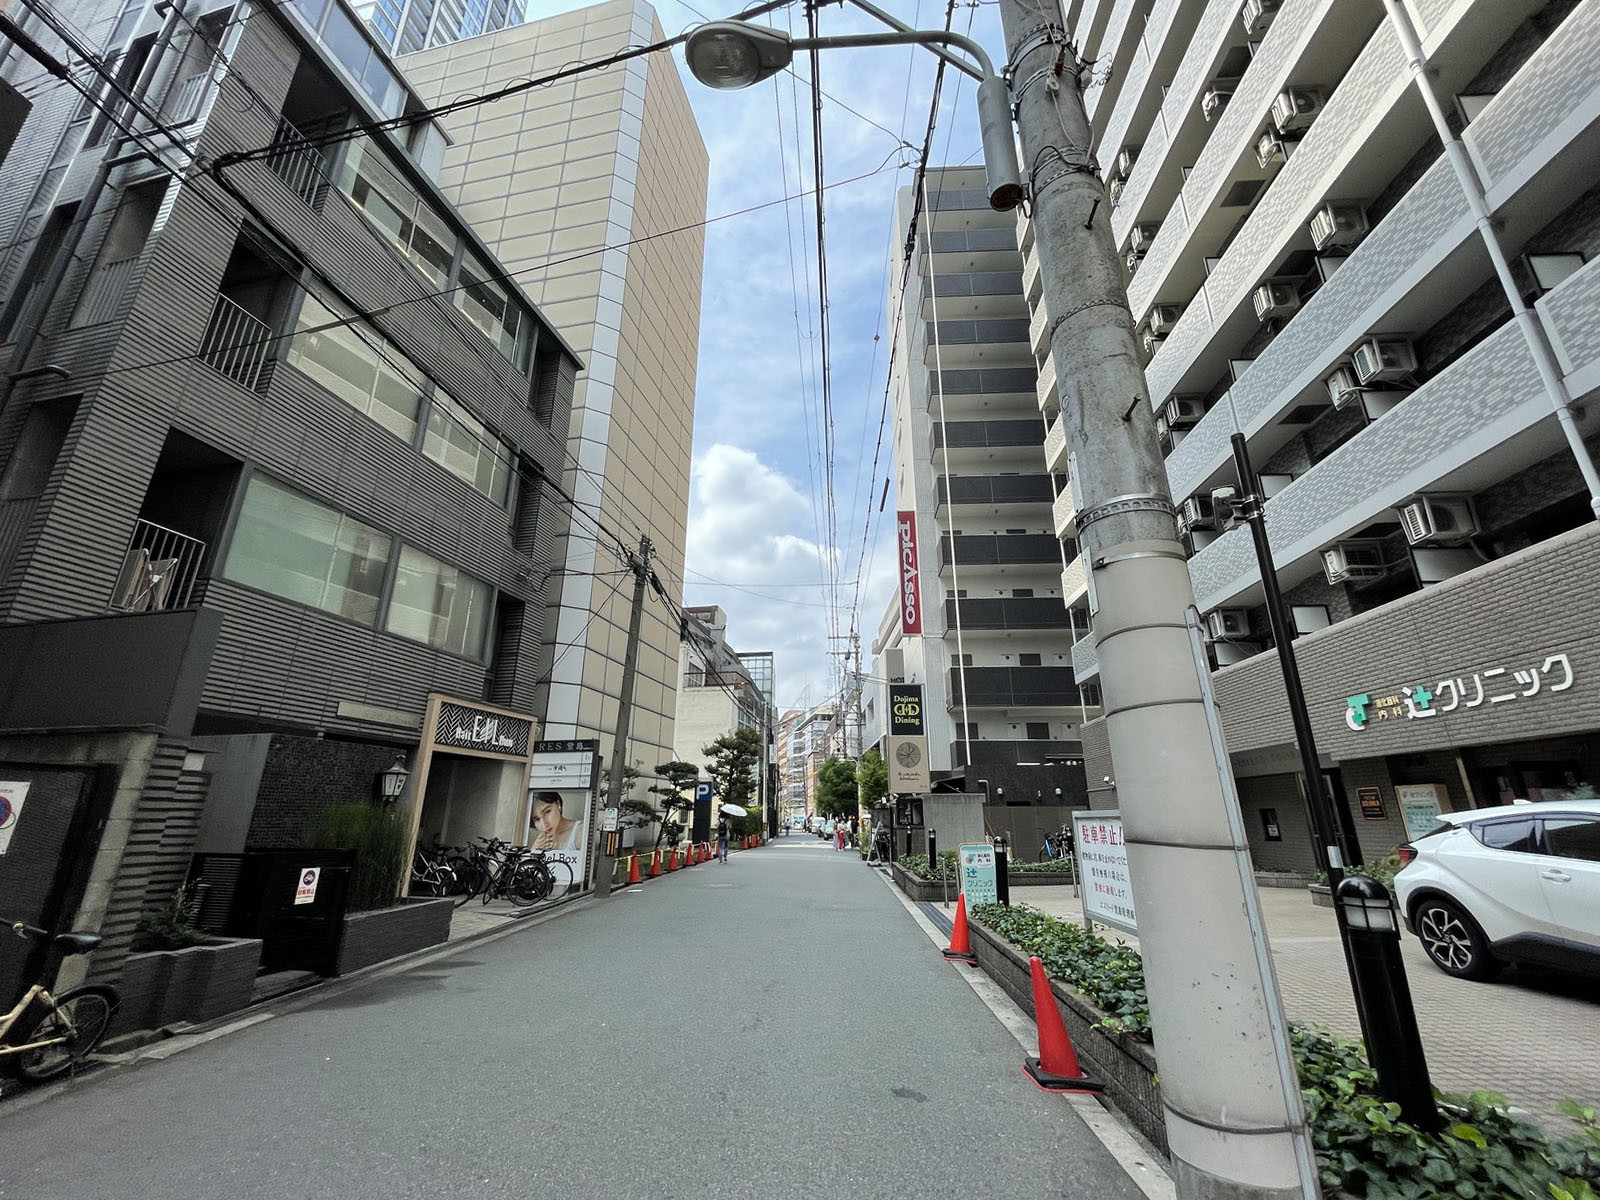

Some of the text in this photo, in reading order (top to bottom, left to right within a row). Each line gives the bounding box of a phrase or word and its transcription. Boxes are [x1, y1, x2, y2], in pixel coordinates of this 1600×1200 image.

[1402, 653, 1574, 720] 辻クリニック
[894, 695, 919, 703] Dojima
[895, 716, 920, 725] Dining
[455, 727, 472, 740] Hair
[696, 784, 709, 800] P
[1081, 824, 1125, 846] 駐車禁止!
[558, 852, 578, 864] Box
